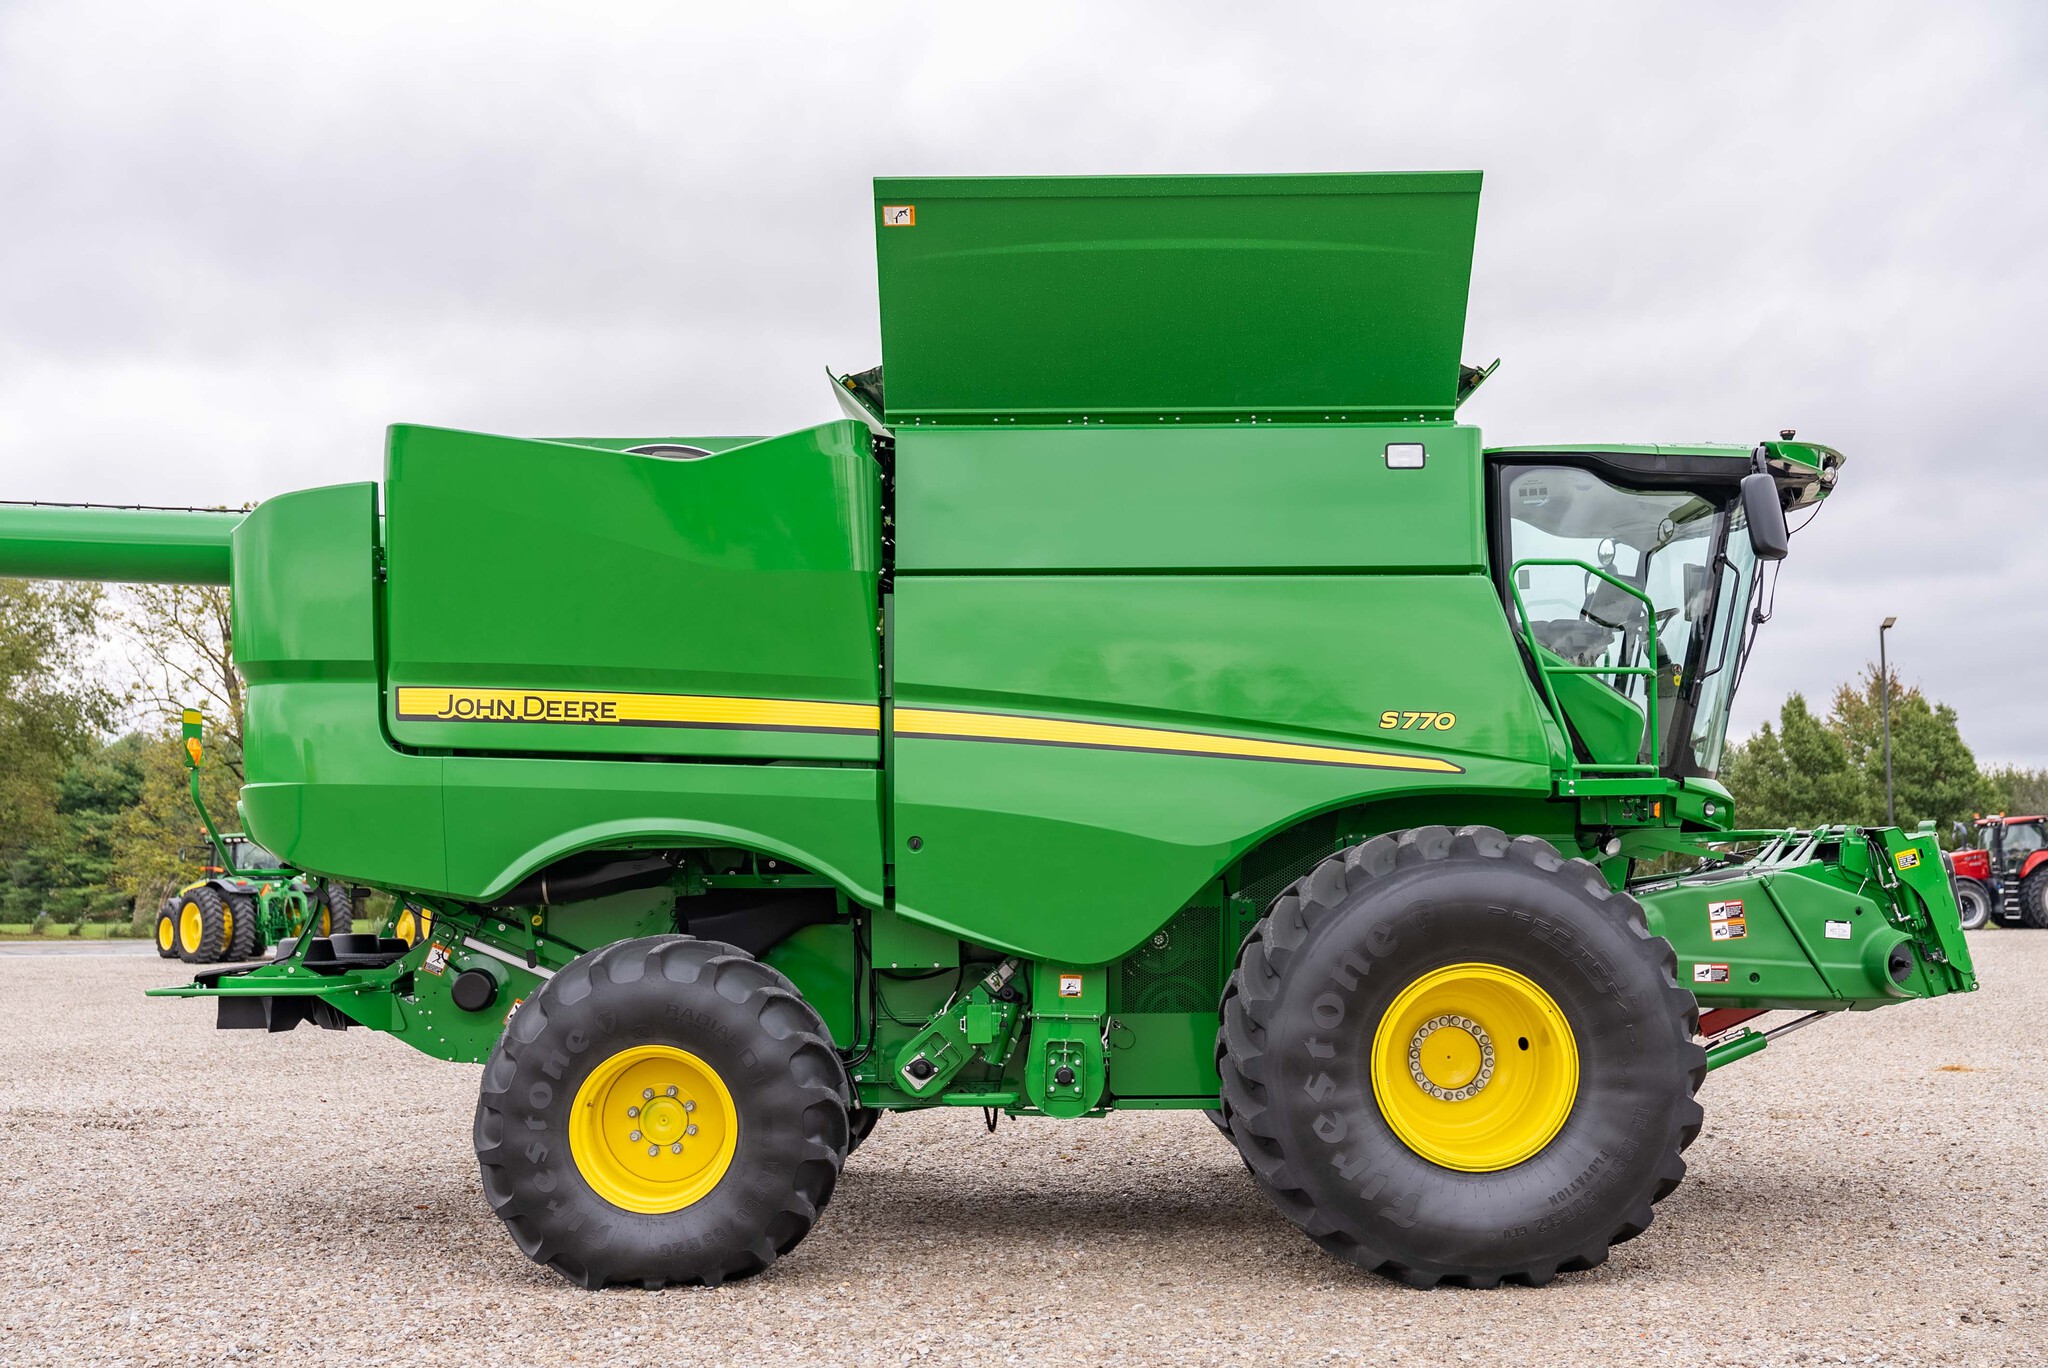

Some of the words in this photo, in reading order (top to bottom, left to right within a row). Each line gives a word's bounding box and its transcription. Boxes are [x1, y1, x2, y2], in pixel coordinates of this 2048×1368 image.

[438, 694, 516, 717] JOHN
[523, 696, 618, 719] DEERE
[1379, 710, 1456, 731] S770
[1303, 920, 1423, 1229] Firestone
[523, 1028, 614, 1250] Firestone
[1547, 1150, 1610, 1207] FLOTATION
